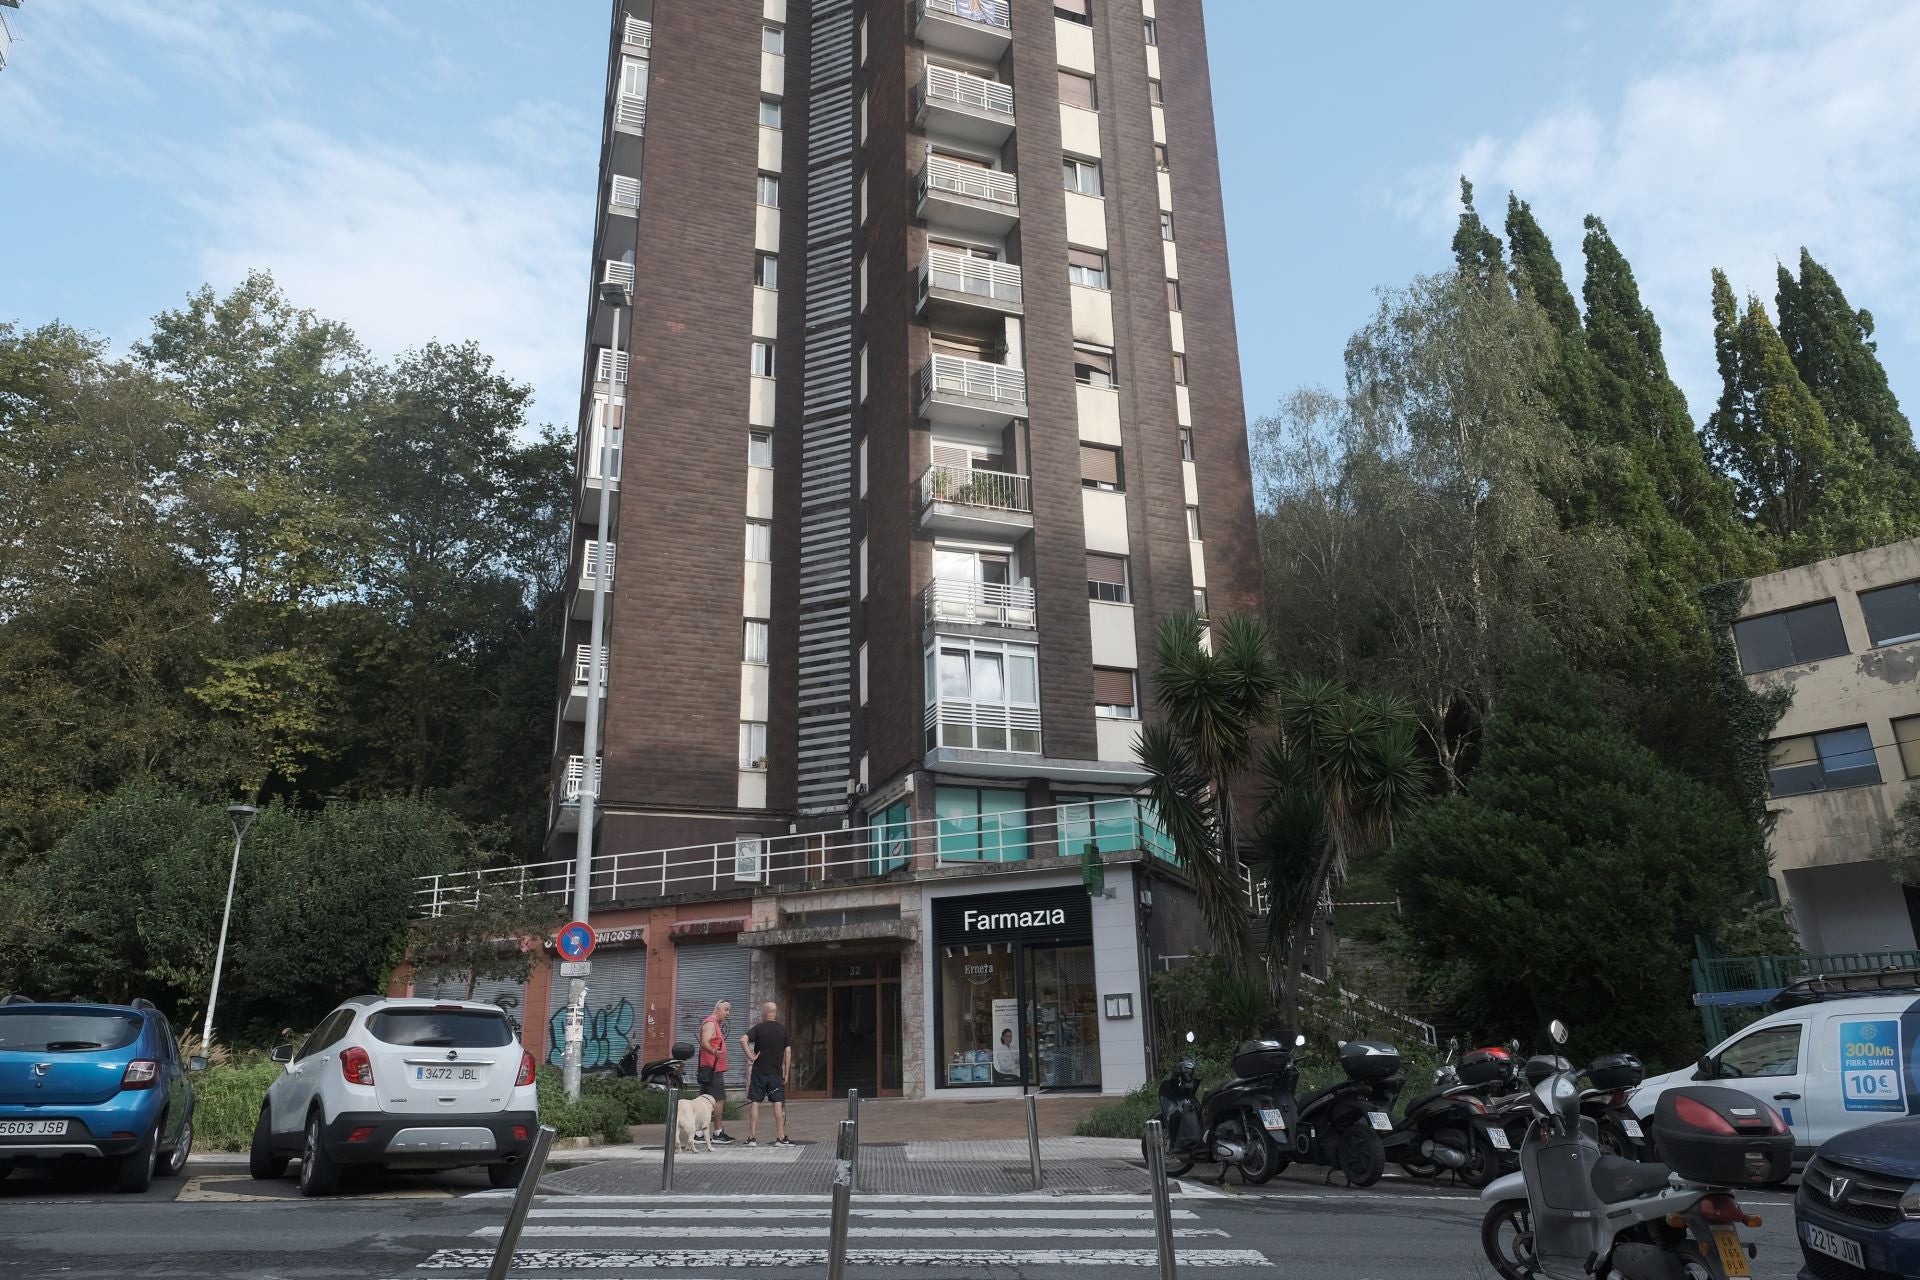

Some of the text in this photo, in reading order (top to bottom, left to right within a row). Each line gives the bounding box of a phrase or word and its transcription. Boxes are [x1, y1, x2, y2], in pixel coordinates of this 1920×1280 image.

[964, 908, 1065, 931] Farmazia
[425, 1068, 478, 1080] 3472 JBL
[0, 1121, 64, 1134] 5603 JSB
[1812, 1228, 1838, 1254] 2215
